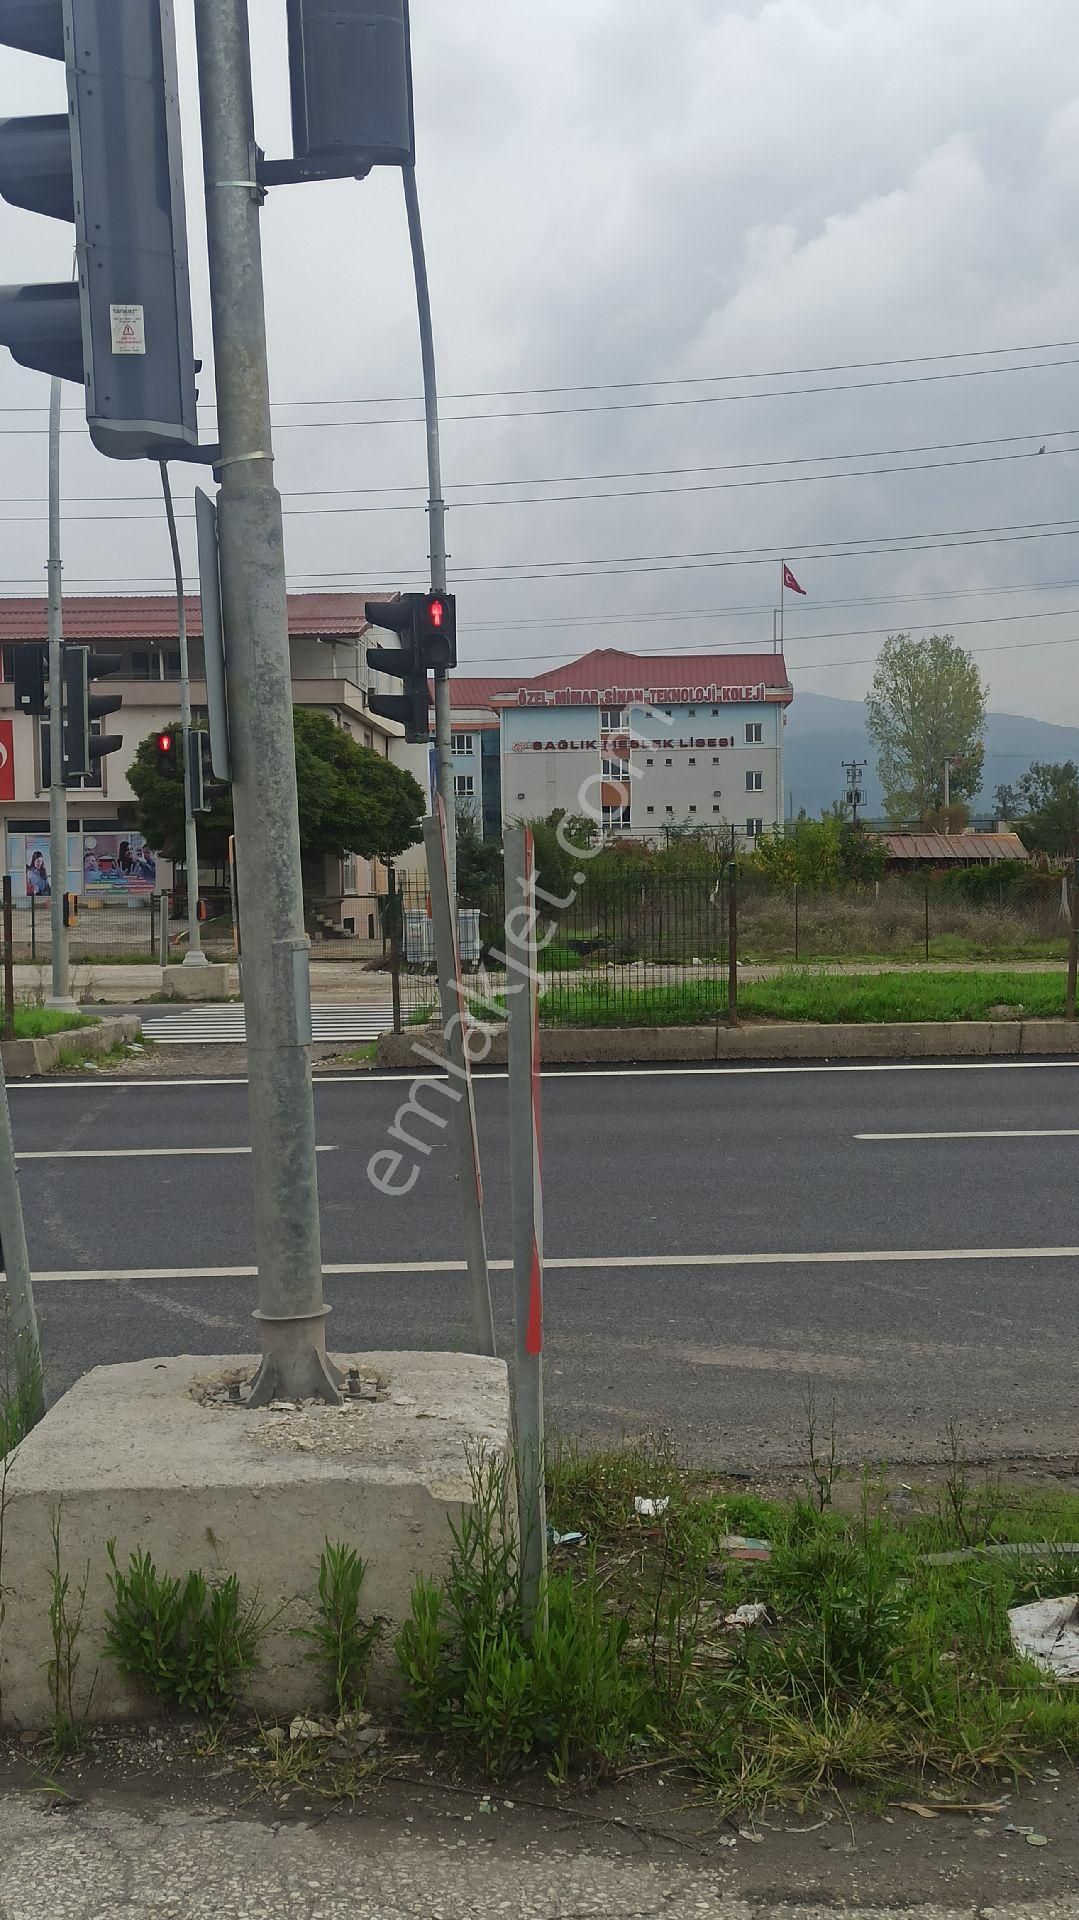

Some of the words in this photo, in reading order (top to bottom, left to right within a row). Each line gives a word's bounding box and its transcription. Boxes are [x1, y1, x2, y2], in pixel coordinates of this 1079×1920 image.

[518, 687, 549, 706] ÖZEL
[554, 687, 600, 706] MİMAR
[604, 686, 645, 705] SİNAN
[649, 684, 717, 703] TEKNOLOJİ
[722, 683, 765, 702] KOLEJİ
[532, 738, 598, 751] SAĞLIK
[679, 735, 735, 748] LİSESİ
